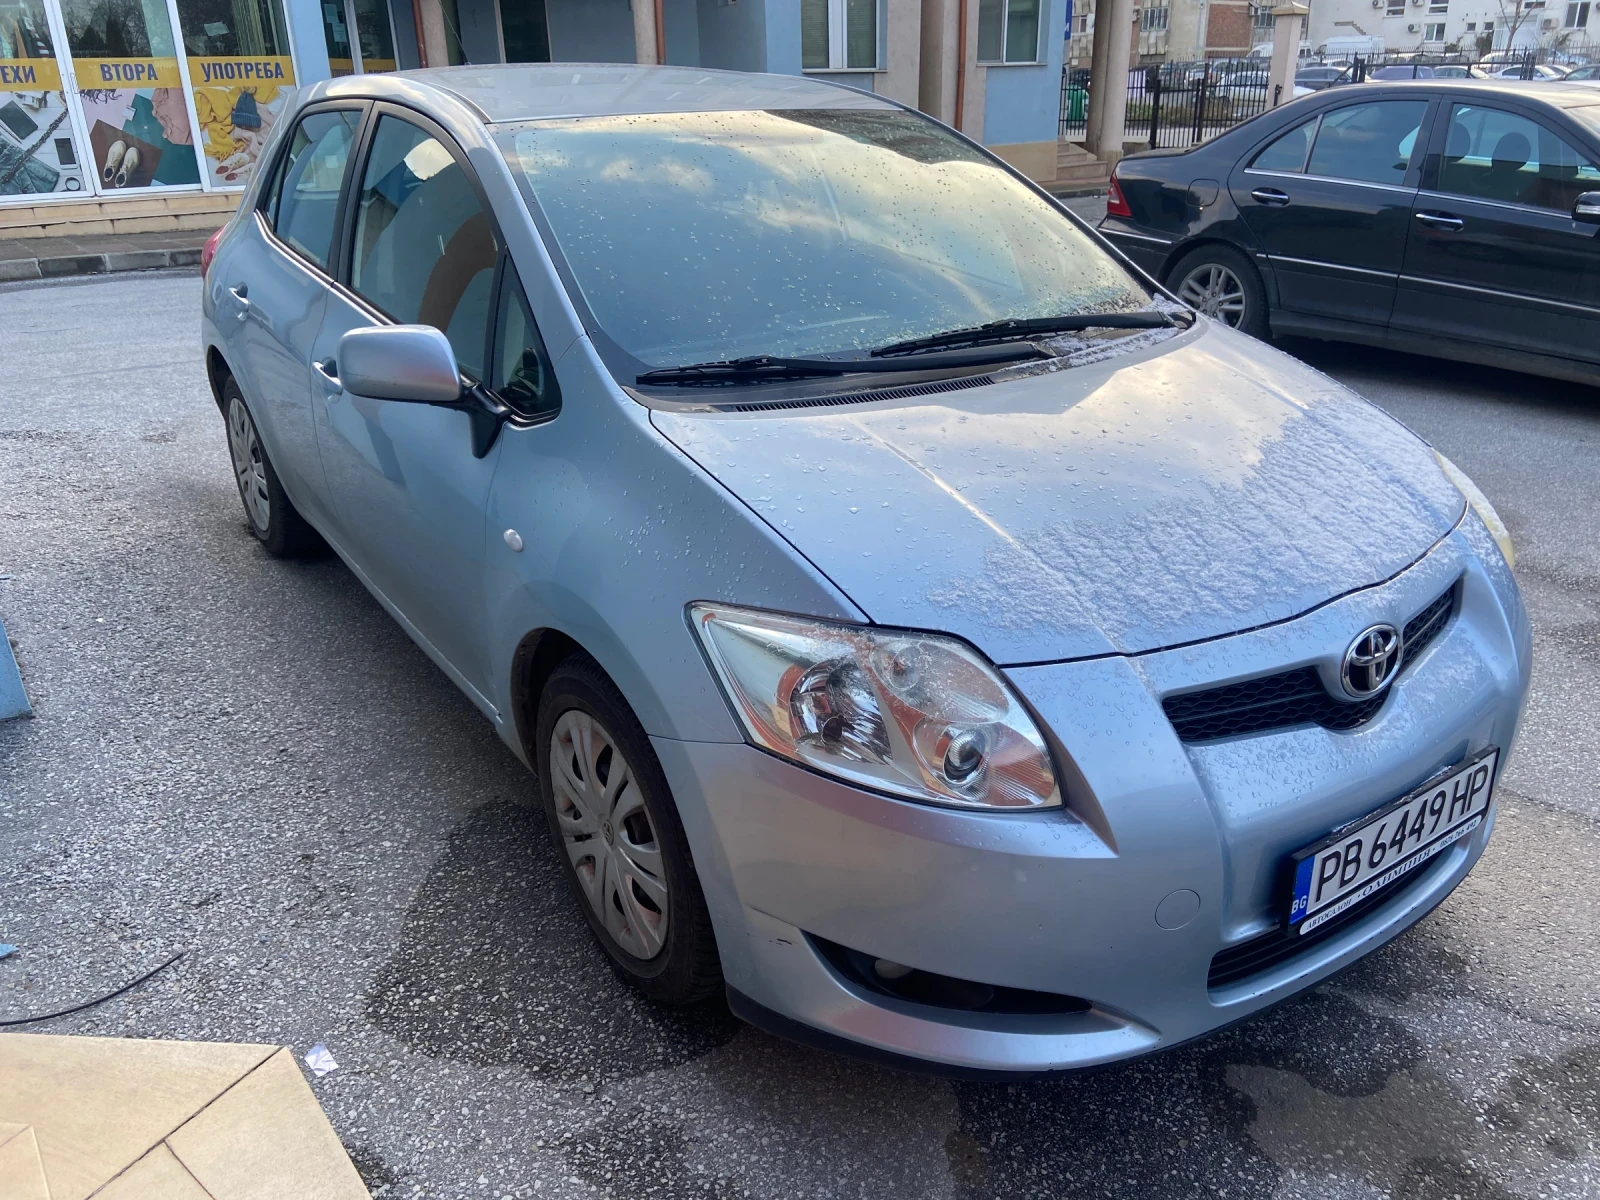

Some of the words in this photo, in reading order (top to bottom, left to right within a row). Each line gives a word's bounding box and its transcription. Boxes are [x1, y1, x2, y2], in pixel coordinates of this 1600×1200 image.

[0, 65, 37, 84] ЕХИ
[99, 63, 159, 82] ВТОРА
[200, 62, 285, 83] УПОТРЕБА
[1315, 836, 1363, 903] PB
[1368, 789, 1447, 870] 6449
[1447, 764, 1489, 824] HP
[1291, 894, 1308, 915] BG
